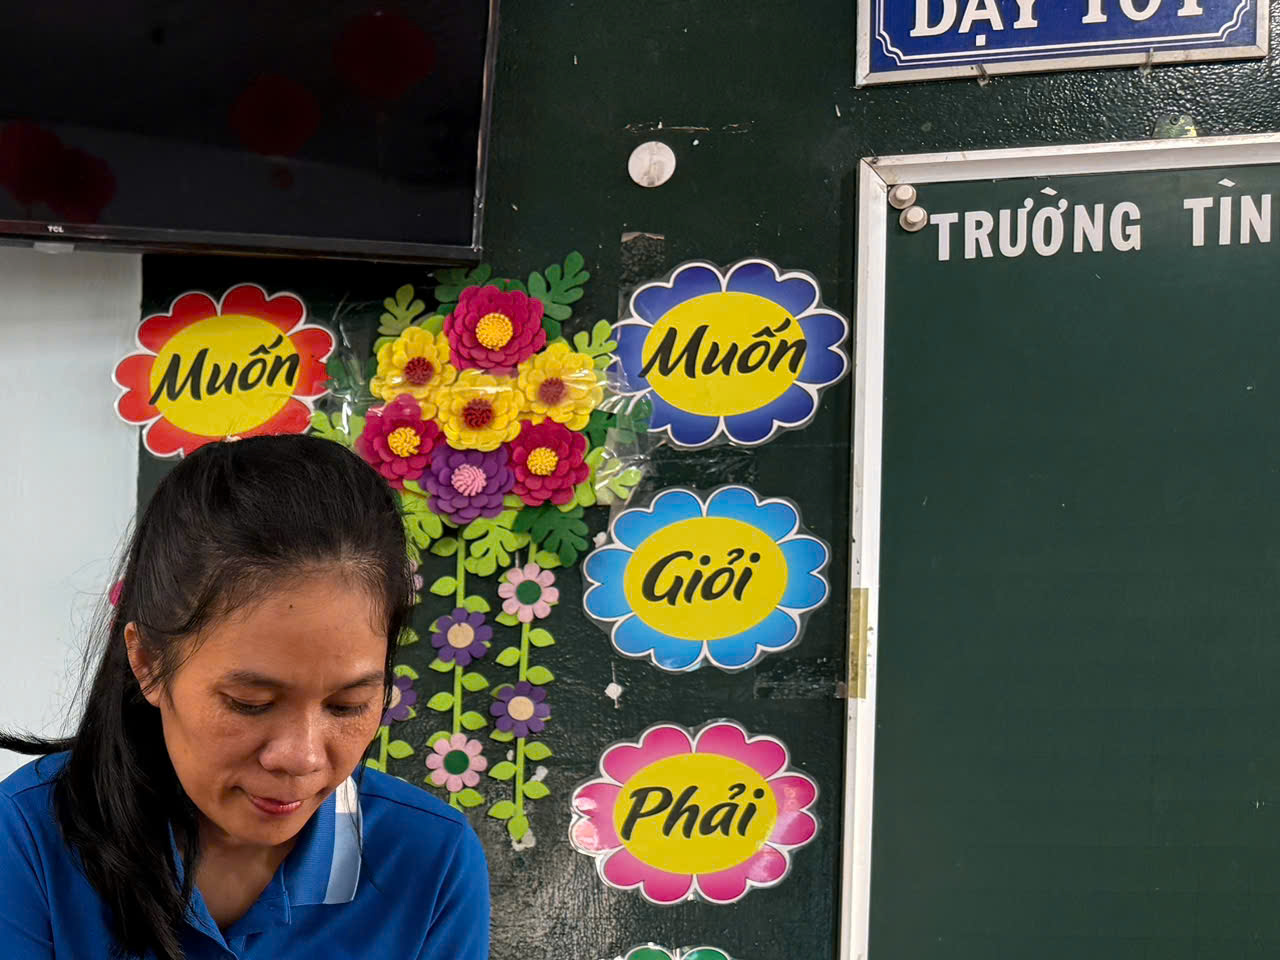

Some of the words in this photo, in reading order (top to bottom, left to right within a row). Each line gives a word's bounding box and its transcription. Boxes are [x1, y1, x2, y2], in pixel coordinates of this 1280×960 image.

[47, 225, 64, 233] TCL
[930, 186, 1141, 261] TRƯỜNG
[1183, 177, 1271, 247] TÌN
[149, 334, 300, 405] Muốn
[638, 318, 807, 379] Muốn
[641, 548, 760, 606] Giỏi
[620, 783, 765, 841] Phải
